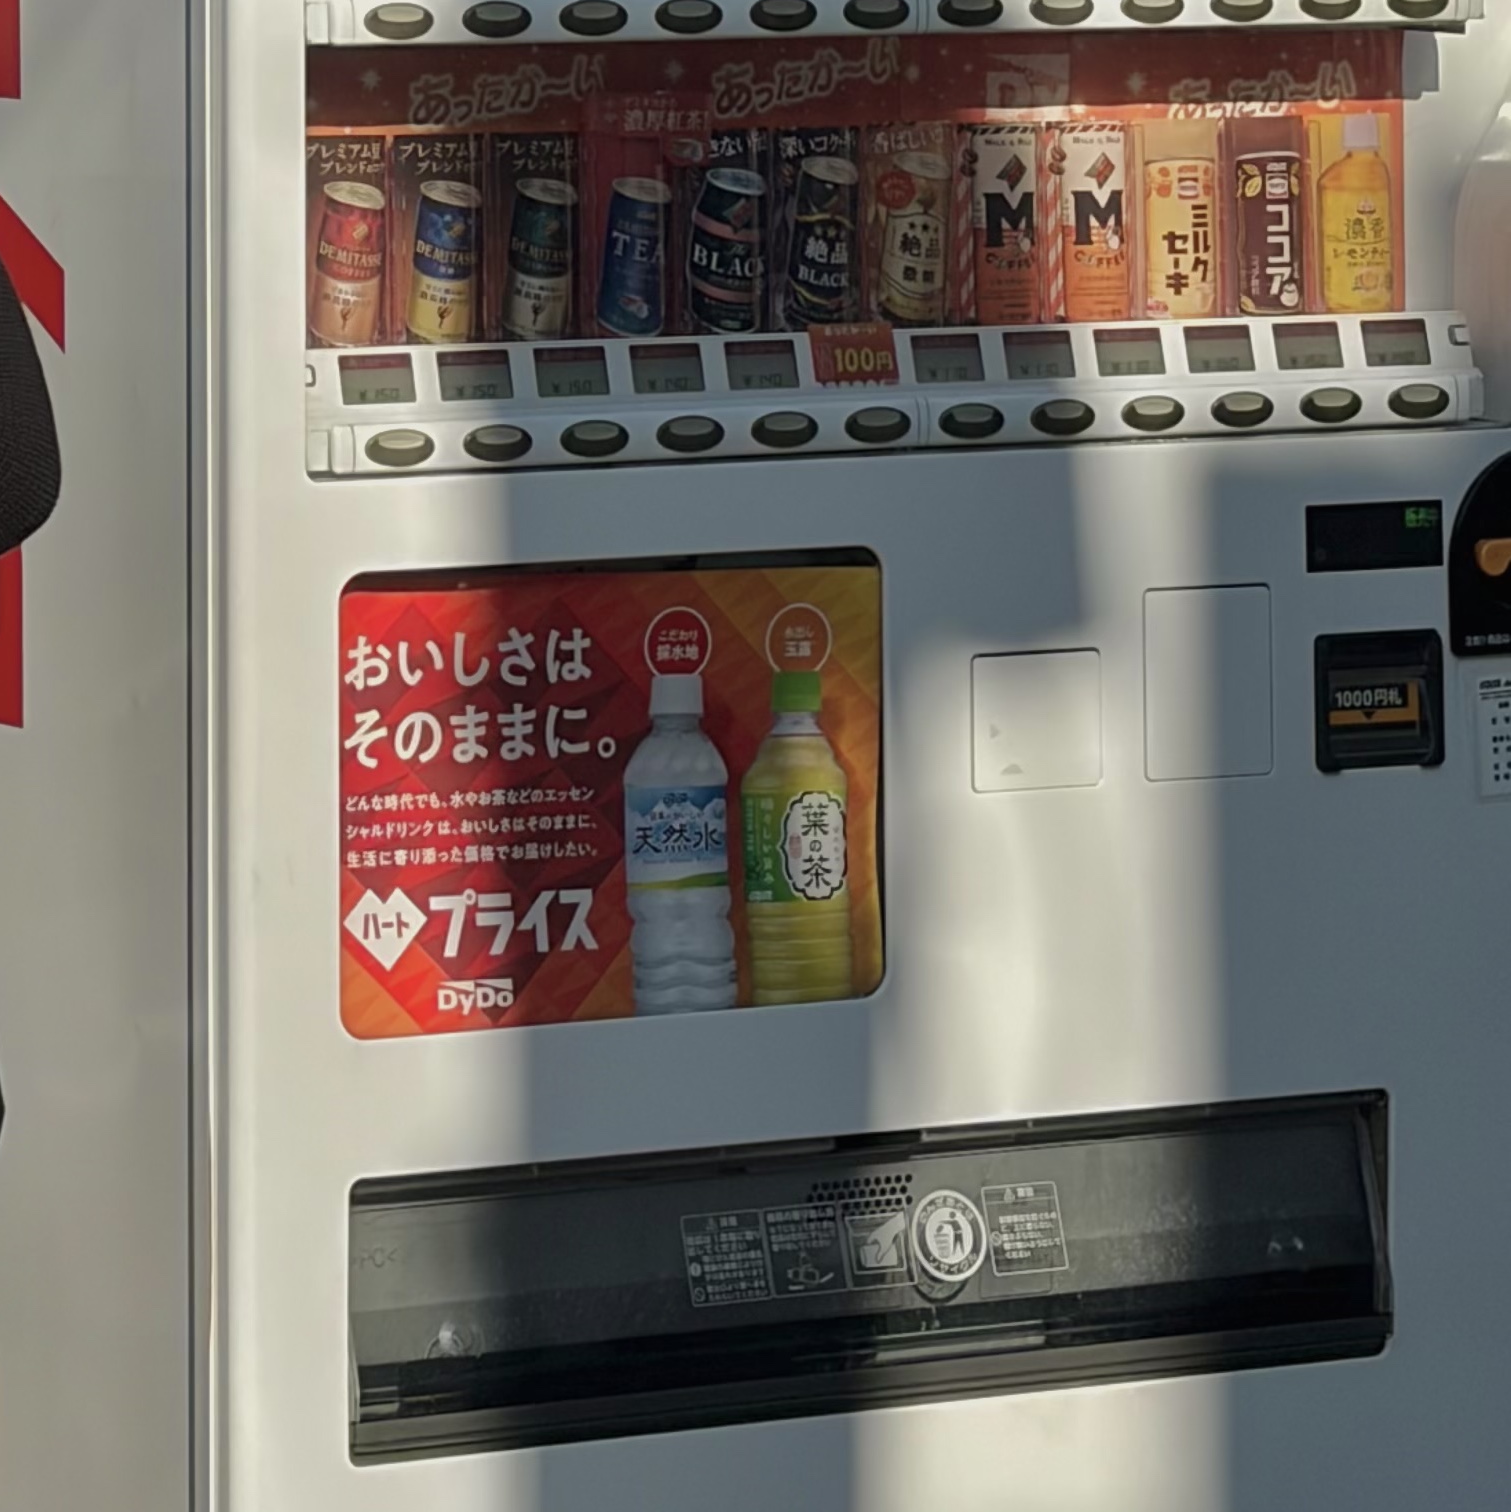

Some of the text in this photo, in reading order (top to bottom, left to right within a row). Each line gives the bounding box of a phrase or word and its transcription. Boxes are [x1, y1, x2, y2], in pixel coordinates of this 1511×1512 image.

[983, 192, 1036, 248] M
[1071, 190, 1125, 245] M
[1191, 204, 1211, 282] ミルク
[1266, 204, 1292, 295] ココア
[1161, 231, 1190, 296] セーキ
[834, 347, 893, 373] 100円
[344, 627, 592, 691] おいしさは
[1334, 688, 1403, 708] 1000円札
[344, 703, 616, 769] そのままに。
[632, 823, 722, 854] 天然水
[801, 803, 832, 889] 葉の茶
[363, 888, 599, 958] ハート プライス
[438, 978, 513, 1015] DyDo
